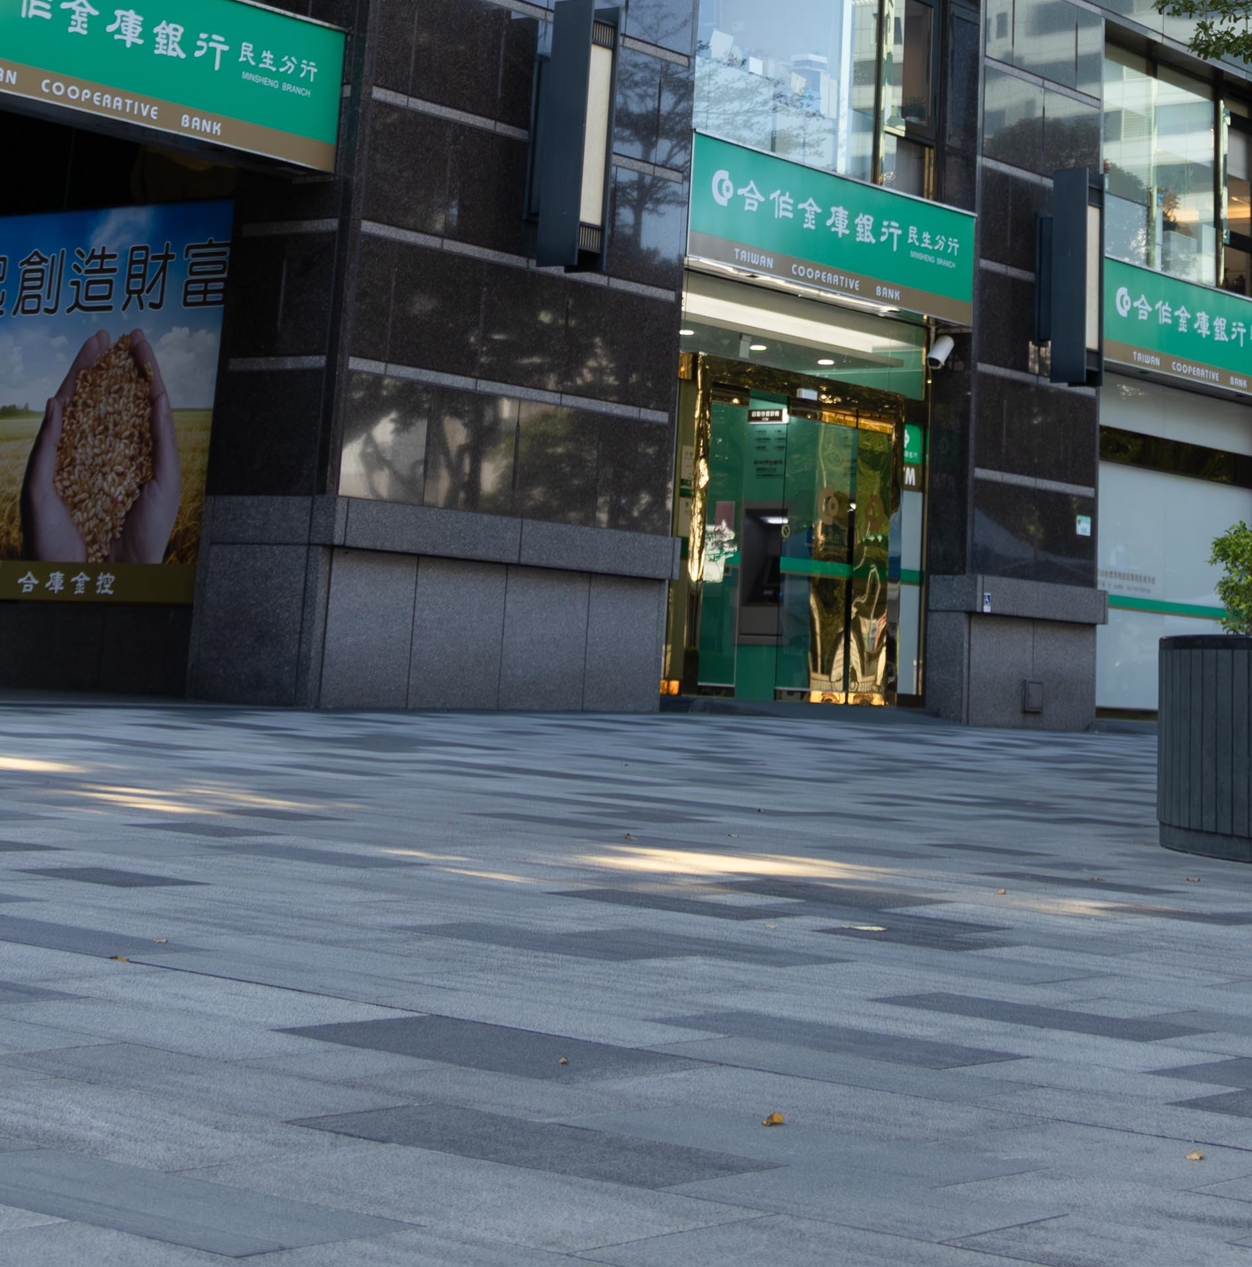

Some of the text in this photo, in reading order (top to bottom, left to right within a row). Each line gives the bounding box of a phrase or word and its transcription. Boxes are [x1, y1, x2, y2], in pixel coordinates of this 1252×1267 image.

[238, 41, 318, 82] 民生分行
[241, 71, 311, 98] MINSHENG BRANCH
[41, 79, 159, 120] COOPERATIVE
[181, 114, 222, 136] BANK
[737, 180, 903, 253] 合作金庫銀行
[907, 225, 960, 257] 民生分行
[0, 236, 232, 318] 創造財富
[734, 248, 901, 301] TAIWAN COOPERATIVE BANK
[1133, 294, 1247, 348] 合作金庫銀行
[1133, 351, 1248, 389] TAIWAN COOPERATIVE BANK
[17, 570, 116, 595] 合庫金控
